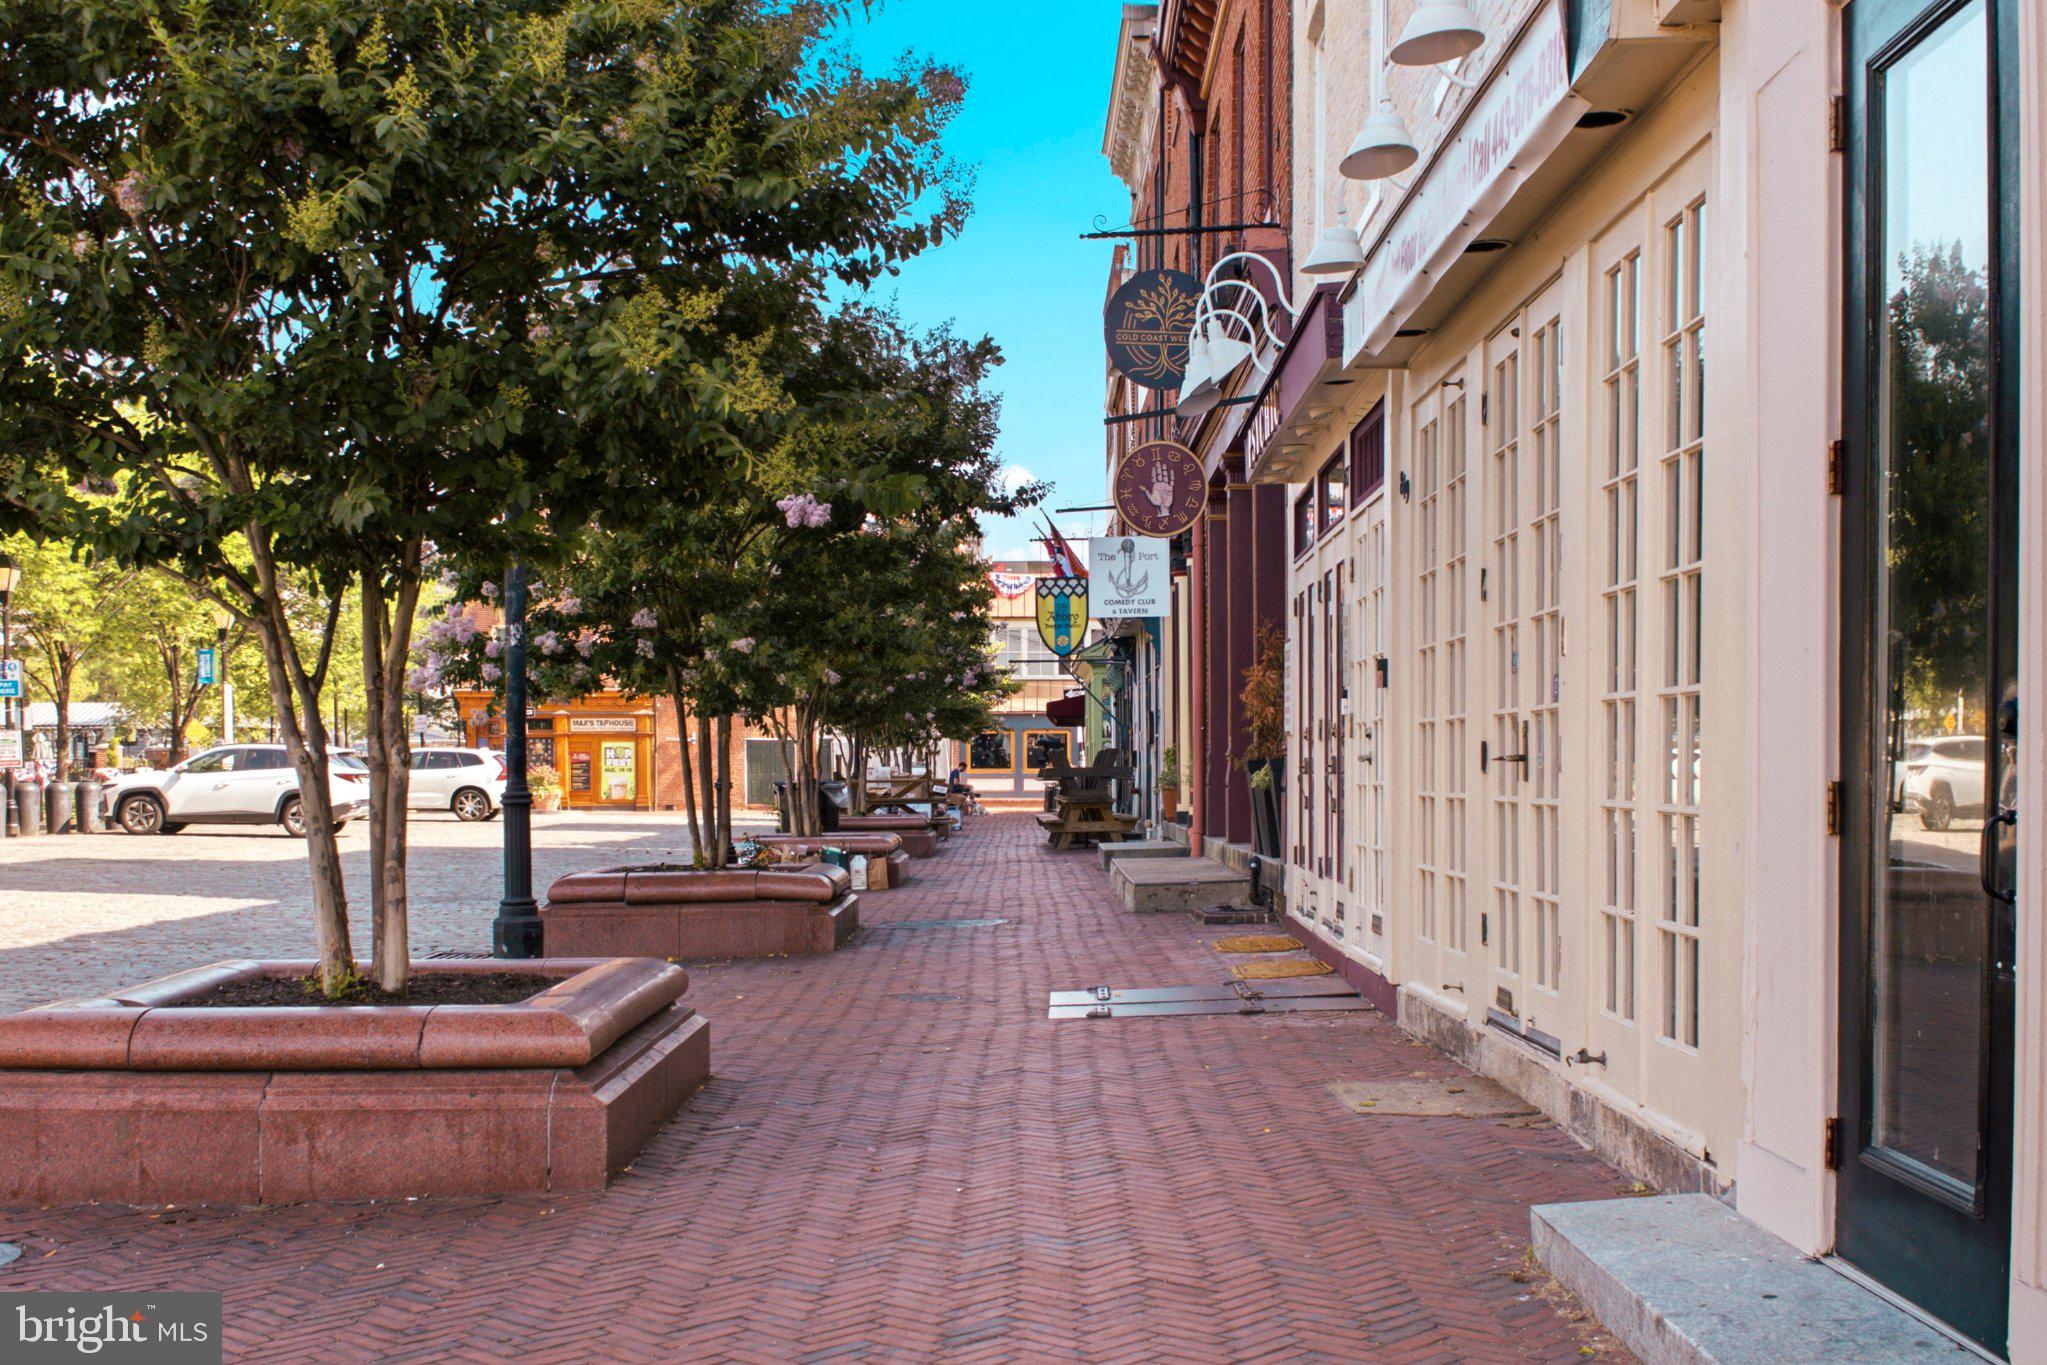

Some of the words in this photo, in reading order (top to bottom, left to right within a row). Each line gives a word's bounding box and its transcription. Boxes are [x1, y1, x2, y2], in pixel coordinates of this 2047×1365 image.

[1141, 334, 1168, 342] COAST
[1098, 552, 1116, 561] The
[1138, 552, 1159, 560] Port
